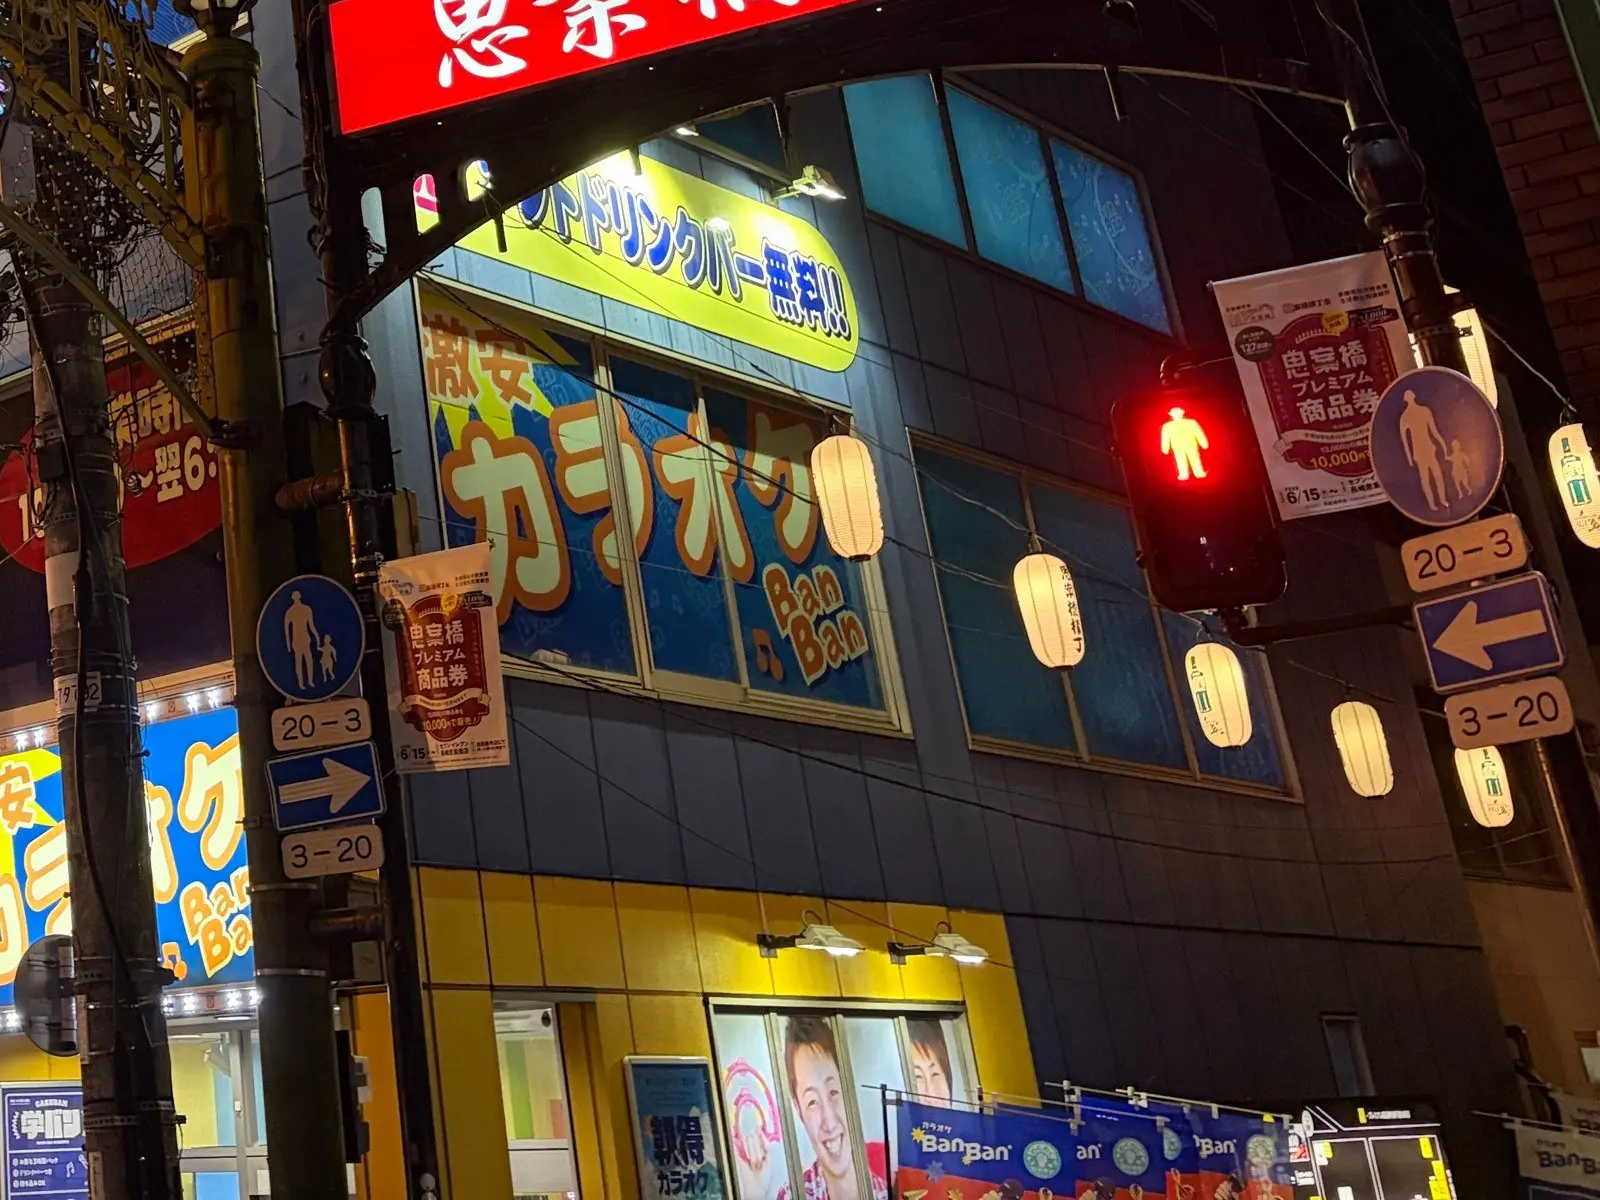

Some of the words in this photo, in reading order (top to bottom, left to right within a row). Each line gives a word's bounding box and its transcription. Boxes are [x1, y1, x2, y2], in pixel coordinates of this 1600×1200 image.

[422, 315, 536, 406] 激安
[1281, 338, 1368, 381] 思案橋
[1292, 370, 1375, 397] プレミアム
[1296, 387, 1381, 425] 商品券
[441, 397, 824, 626] カラオケ
[763, 561, 844, 642] Ban
[409, 618, 465, 650] 思案橋
[789, 605, 869, 688] Ban
[414, 647, 467, 666] プレミアム
[417, 663, 469, 691] 商品券
